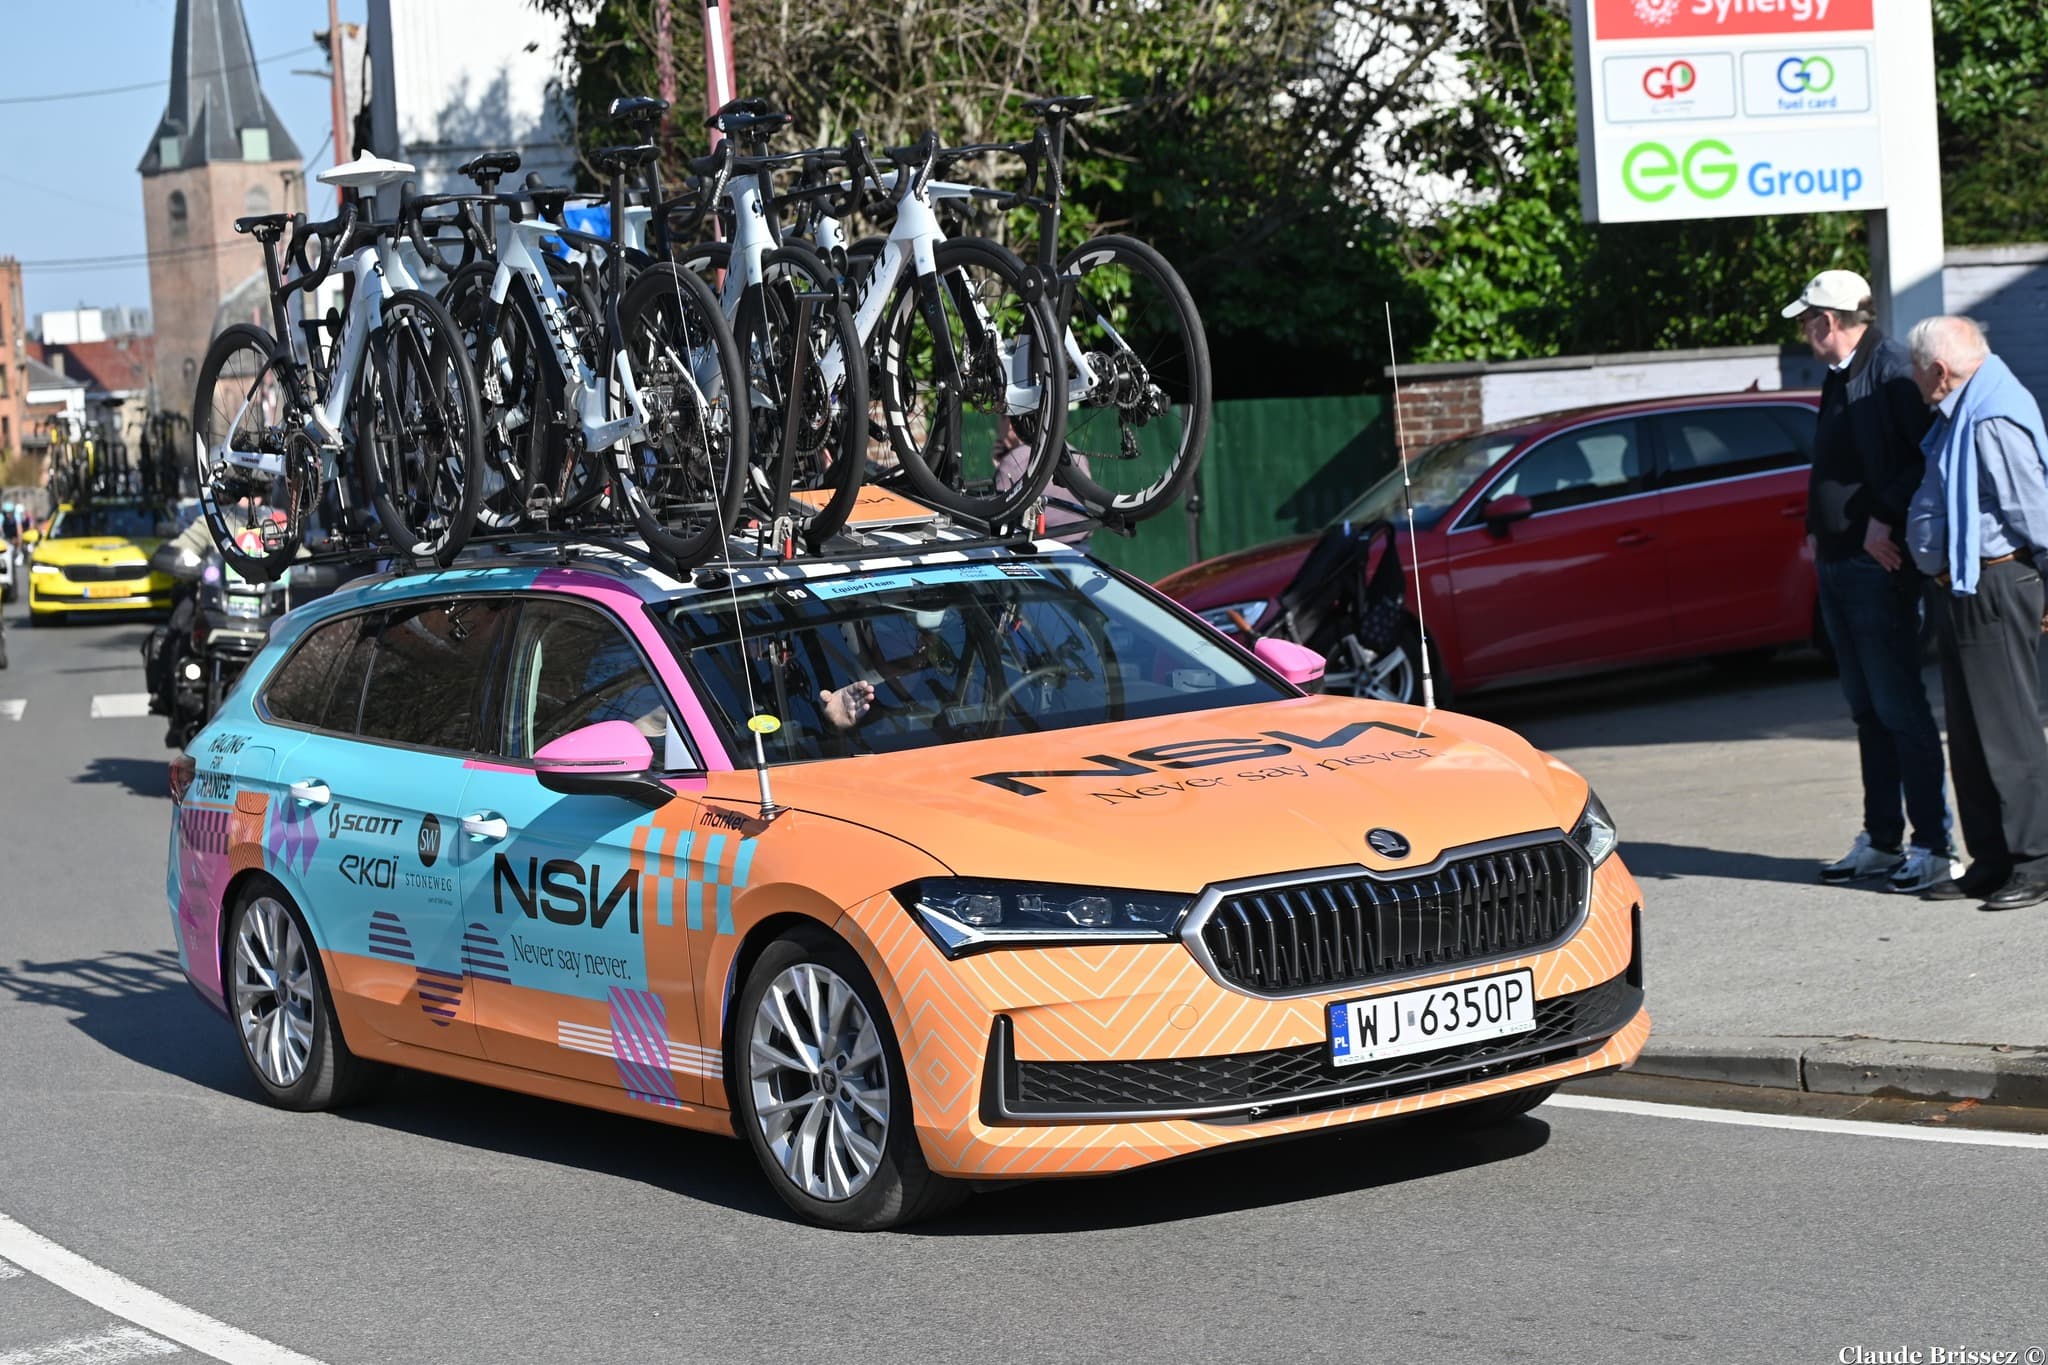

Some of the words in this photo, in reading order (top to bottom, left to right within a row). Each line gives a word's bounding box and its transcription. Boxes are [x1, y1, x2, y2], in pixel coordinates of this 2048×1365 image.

[1749, 161, 1863, 200] Group
[786, 588, 808, 600] 90
[196, 771, 231, 800] CHANGE
[1087, 776, 1232, 805] Never
[1236, 764, 1309, 782] say
[341, 814, 403, 836] SCOTT
[700, 810, 749, 831] marker
[405, 872, 453, 892] STONEWEG
[510, 934, 554, 968] Never
[557, 948, 581, 978] say
[1357, 1001, 1401, 1048] WJ
[1420, 978, 1523, 1036] 6350P
[1334, 1036, 1349, 1049] PL
